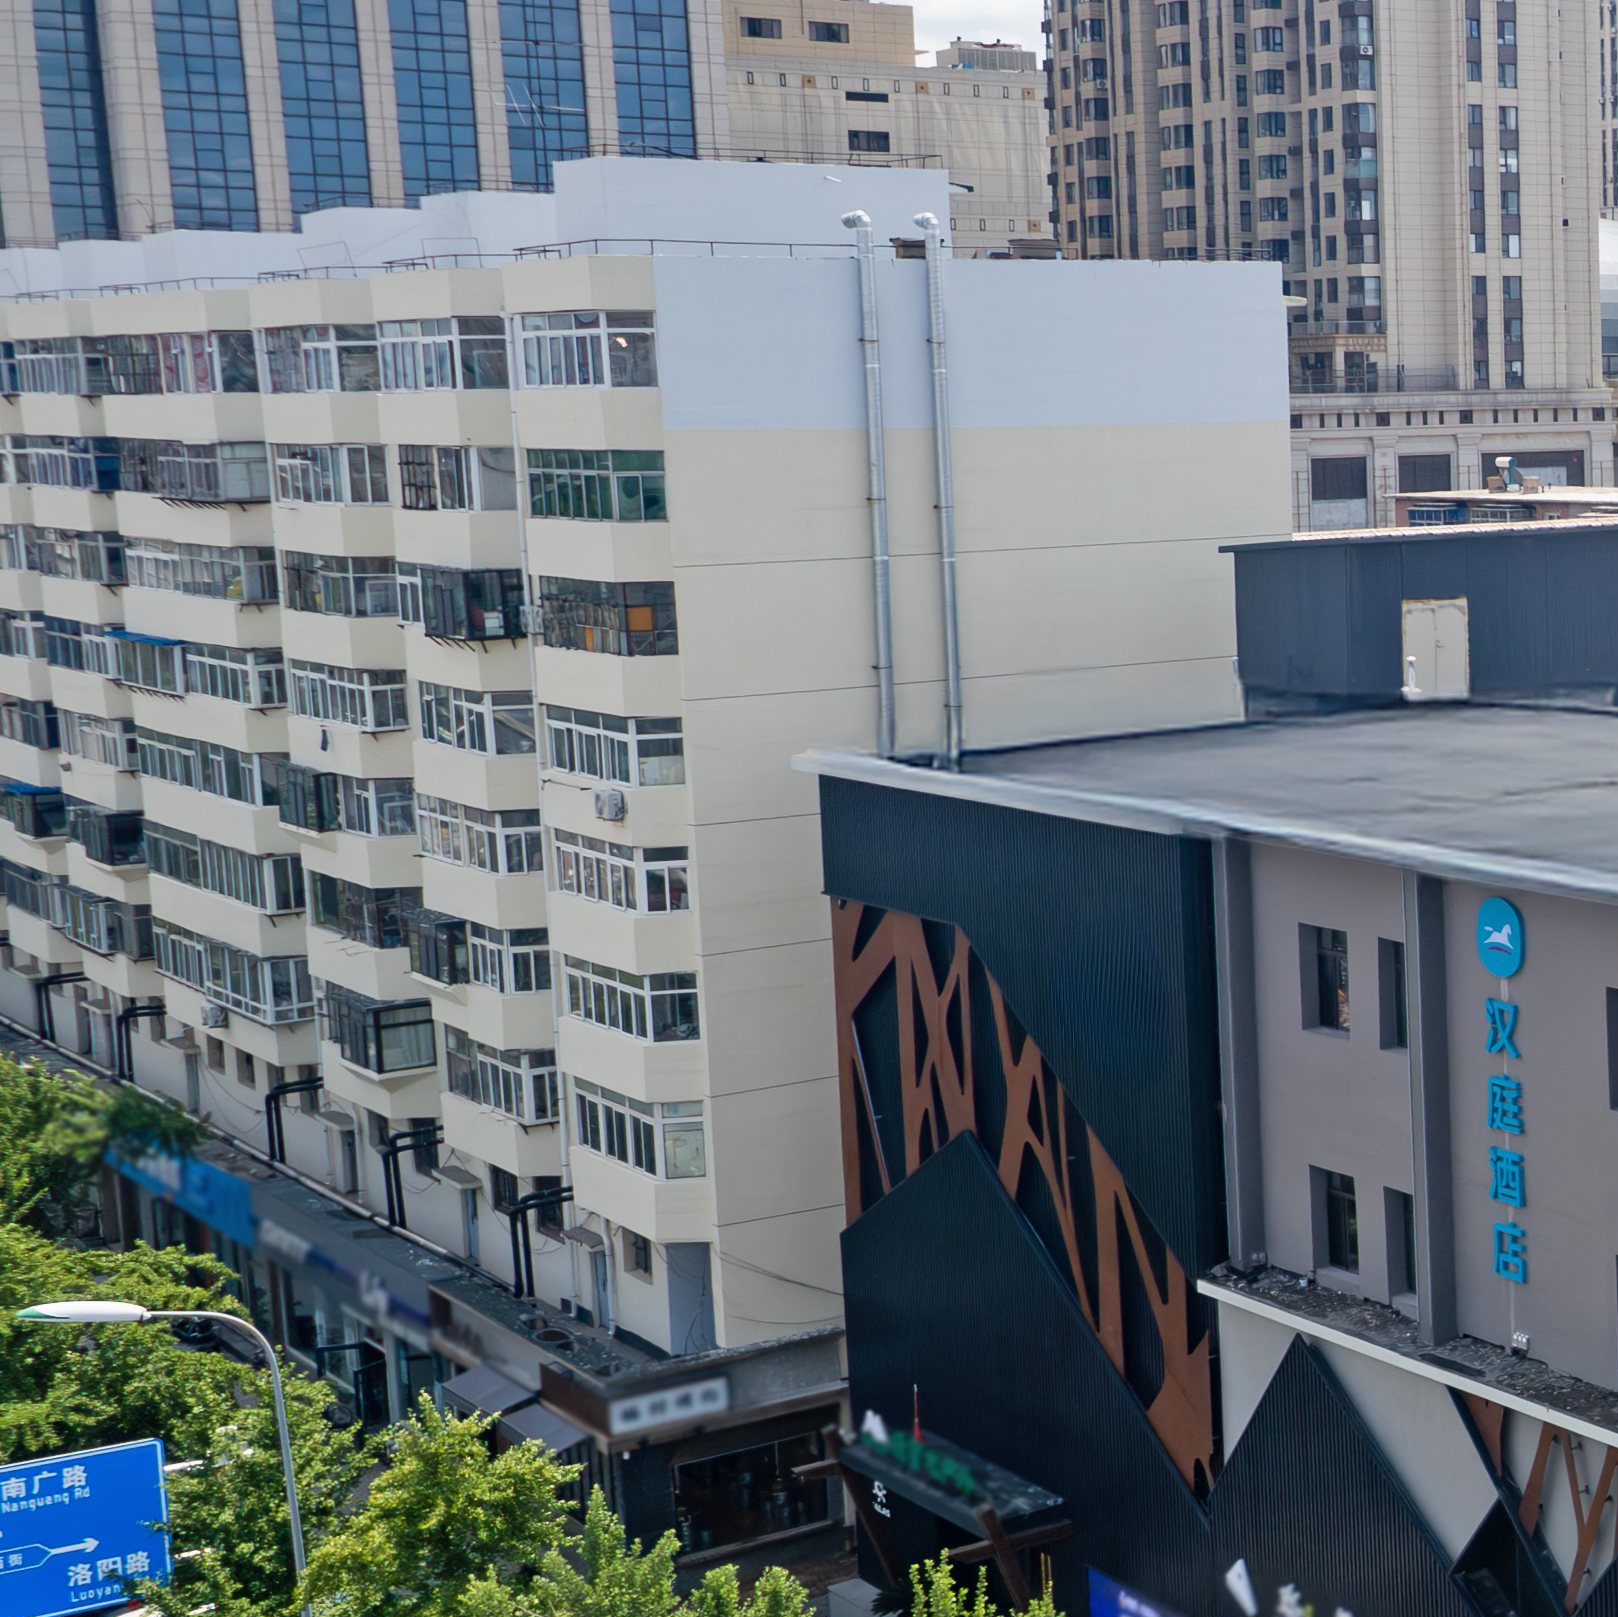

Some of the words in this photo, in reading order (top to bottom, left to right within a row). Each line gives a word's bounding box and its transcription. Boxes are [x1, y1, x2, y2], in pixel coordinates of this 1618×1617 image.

[1485, 998, 1527, 1283] 汉庭酒店
[0, 1465, 88, 1501] 南广路
[1, 1492, 69, 1514] Nanguang
[74, 1485, 91, 1500] Rd
[70, 1584, 122, 1603] Luoyan
